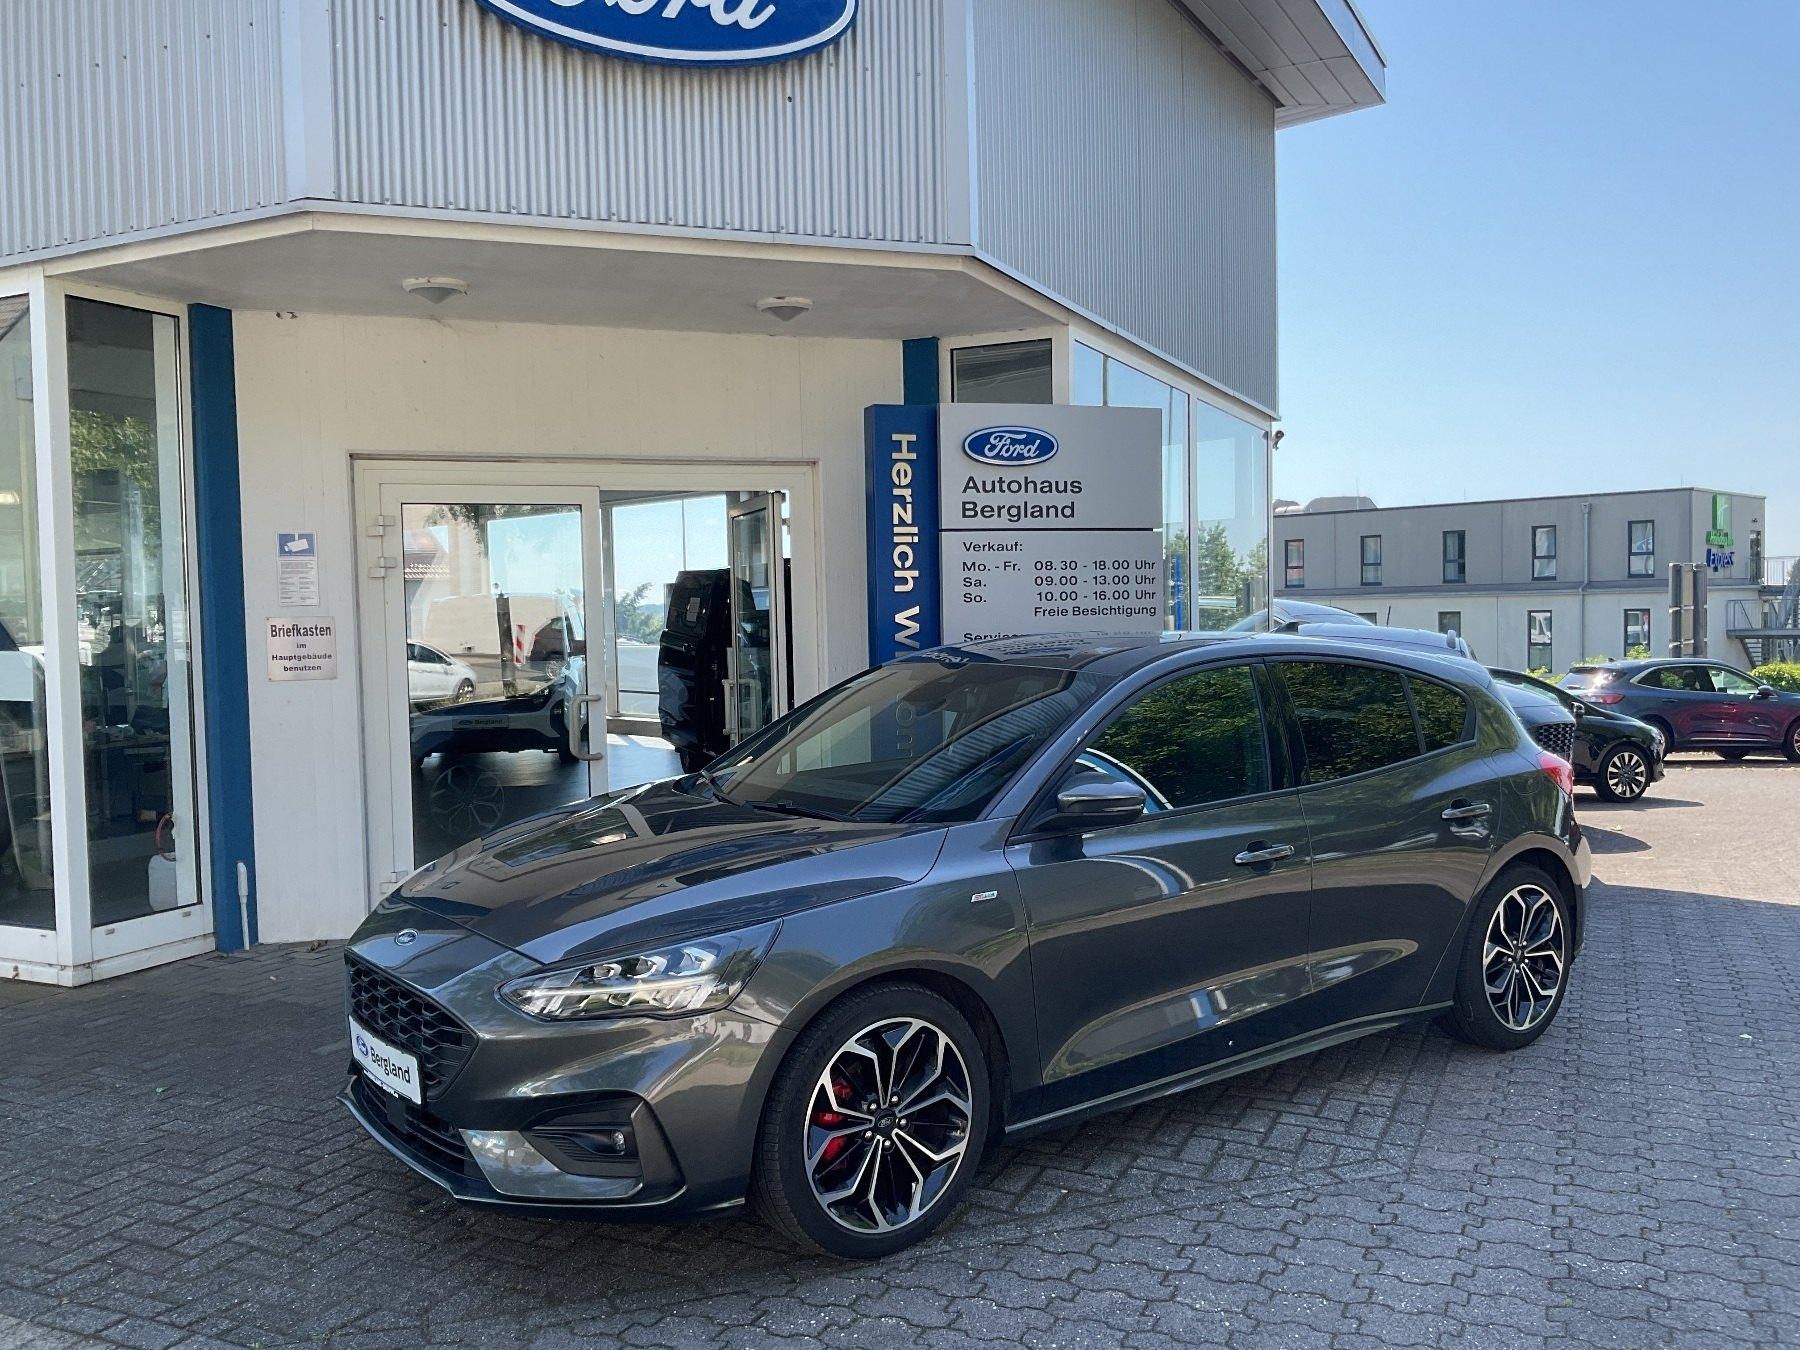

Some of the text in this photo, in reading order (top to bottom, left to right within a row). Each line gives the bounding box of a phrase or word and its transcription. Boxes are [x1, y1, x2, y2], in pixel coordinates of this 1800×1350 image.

[983, 432, 1041, 458] Ford
[962, 476, 1083, 494] Autohaus
[891, 433, 920, 592] Herzlich
[961, 501, 1075, 523] Bergland
[962, 541, 1023, 552] Verkauf:
[962, 561, 991, 572] Mo.
[1003, 561, 1021, 571] Fr.
[1034, 560, 1078, 571] 08.30
[1092, 560, 1130, 570] 18.00
[1135, 560, 1156, 570] Uhr
[962, 577, 987, 587] Sa.
[1034, 575, 1078, 586] 09.00
[1092, 575, 1130, 585] 13.00
[1135, 575, 1156, 585] Uhr
[963, 592, 987, 603] So.
[1036, 591, 1078, 601] 10.00
[1092, 590, 1130, 601] 16.00
[1135, 590, 1156, 600] Uhr
[1034, 605, 1157, 617] Freie Besichtigung
[270, 624, 332, 638] Briefkasten
[271, 653, 333, 661] Hauptgebäude
[370, 1046, 411, 1084] Bergland
